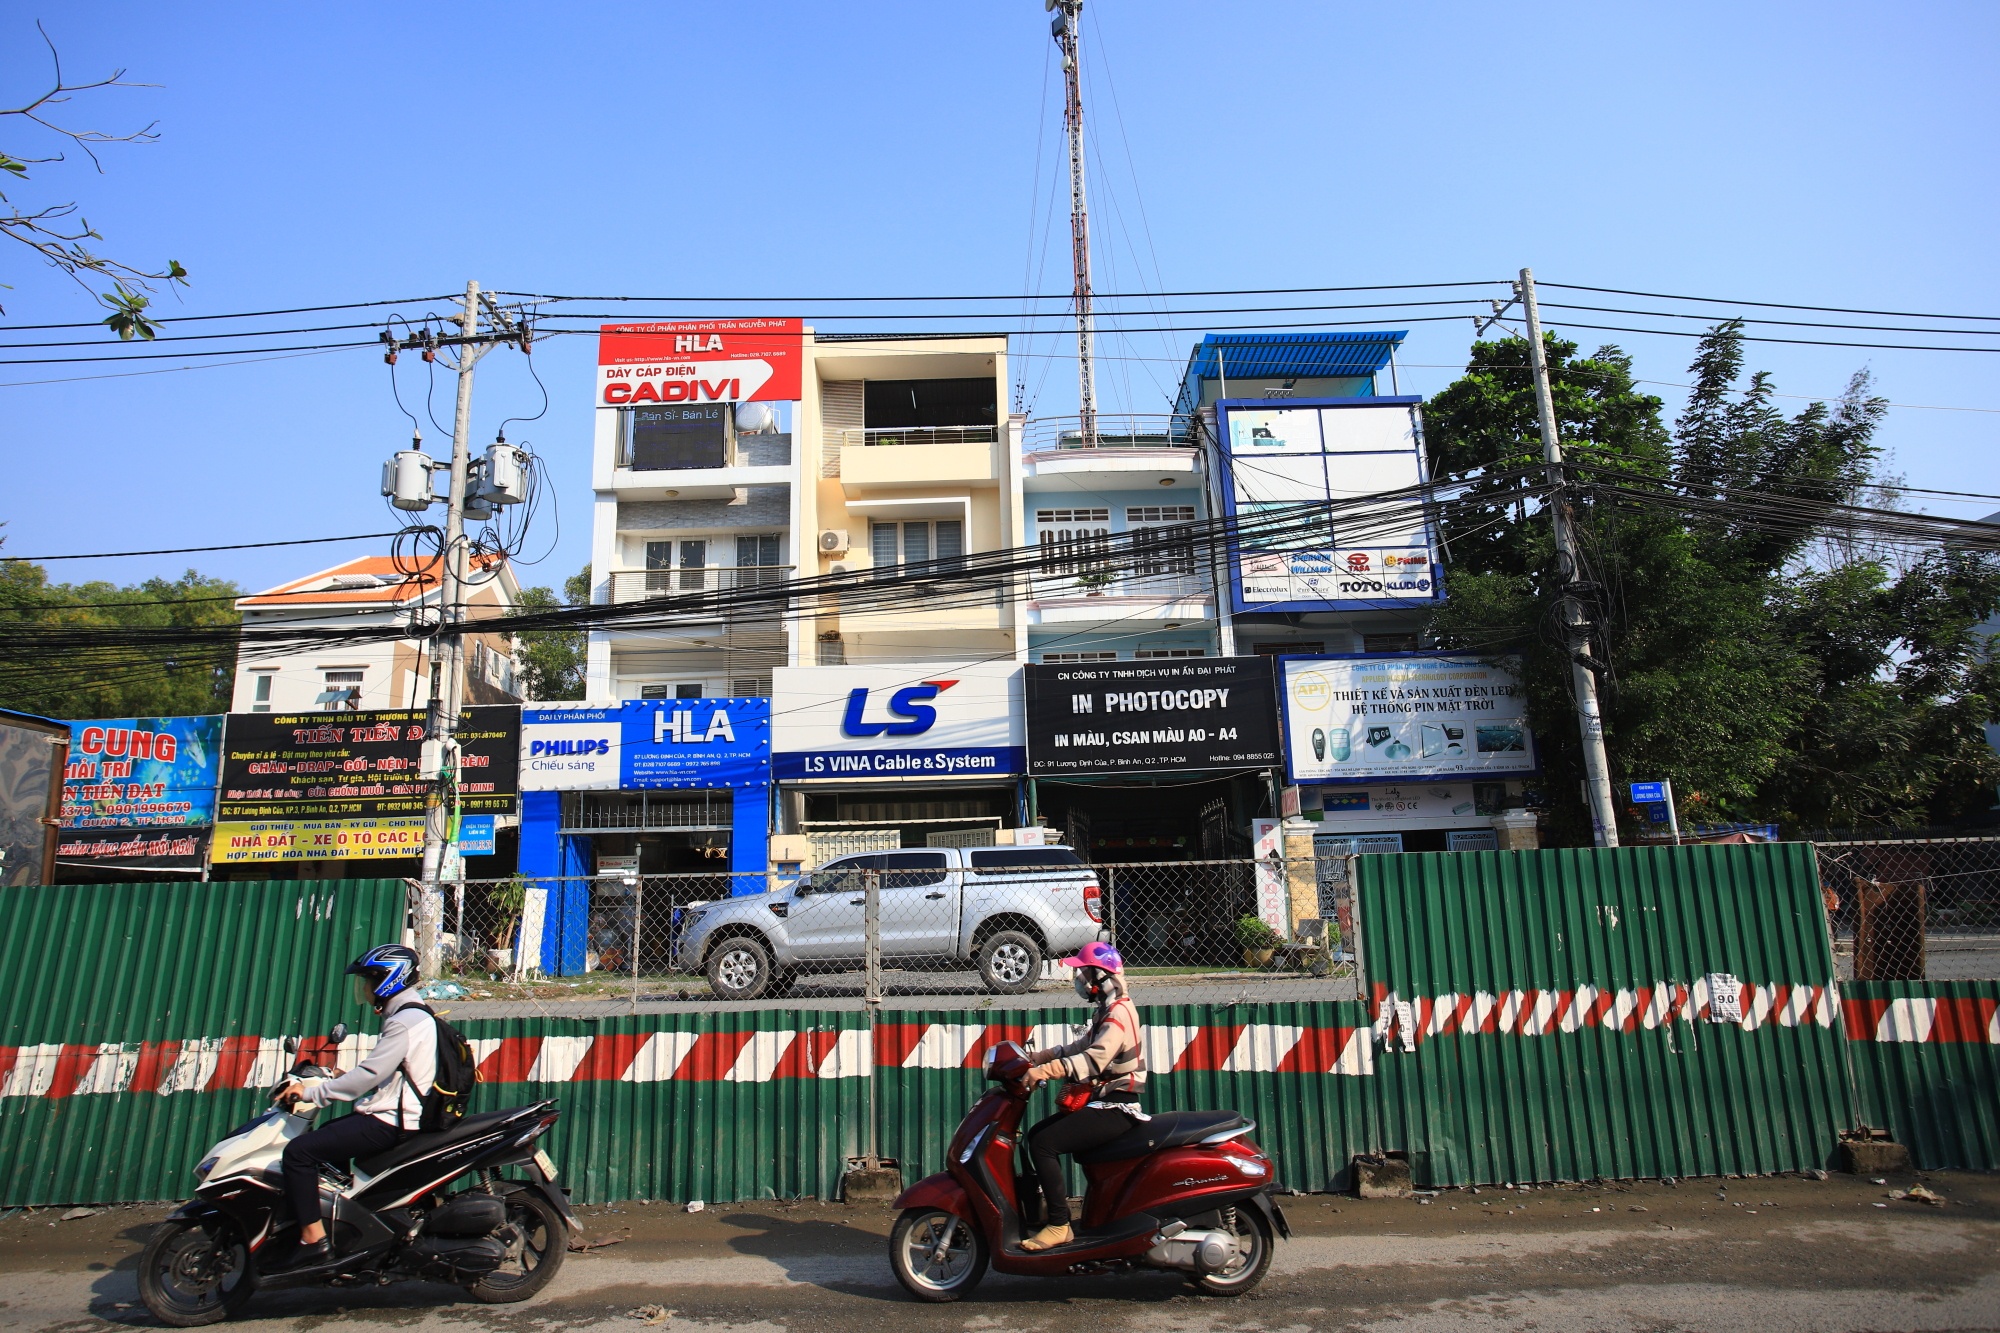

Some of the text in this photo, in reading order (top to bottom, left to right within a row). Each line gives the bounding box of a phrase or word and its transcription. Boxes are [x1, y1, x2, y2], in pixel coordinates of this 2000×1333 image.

[738, 319, 766, 328] NGUYỄN
[768, 319, 786, 327] PHÁT
[675, 334, 724, 352] HLA
[606, 364, 696, 379] DÂY CÁP ĐIỆN
[604, 378, 740, 404] CADIVI
[682, 410, 702, 420] Bán
[1398, 556, 1428, 565] PRIME
[1340, 581, 1383, 592] TOTO
[1386, 582, 1416, 590] KLUDI
[1058, 672, 1070, 680] CN
[1072, 670, 1096, 680] CÔNG
[1098, 671, 1110, 679] TY
[1112, 670, 1134, 678] TNHH
[1136, 668, 1156, 679] DỊCH
[1158, 668, 1170, 678] VỤ
[1182, 665, 1194, 676] ẤN
[1197, 666, 1212, 676] ĐẠI
[1214, 665, 1236, 674] PHÁT
[1298, 684, 1326, 695] APT
[1333, 684, 1513, 702] THIẾT KẾ VÀ SẢN XUẤT ĐÈN LED
[1072, 688, 1230, 714] IN PHOTOCOPY
[1352, 700, 1494, 716] HỆ THỐNG PIN MẶT TRỜI
[274, 716, 298, 724] CÔNG
[300, 716, 310, 724] TY
[356, 714, 367, 722] TƯ
[375, 712, 408, 721] THƯƠNG
[553, 712, 562, 721] LÝ
[563, 712, 585, 721] PHÂN
[586, 712, 606, 720] PHỐI
[843, 687, 939, 737] LS
[293, 724, 346, 744] TIẾN
[350, 722, 401, 742] TIẾN
[654, 710, 736, 744] HLA
[1054, 734, 1069, 748] IN
[1073, 730, 1110, 748] MÀU,
[1112, 730, 1150, 746] CSAN
[1152, 726, 1185, 744] MÀU
[1218, 728, 1238, 740] A4
[81, 726, 177, 764] CUNG
[530, 739, 610, 756] PHILIPS
[231, 751, 255, 762] Chuyên
[282, 750, 294, 760] Đặt
[294, 752, 308, 760] may
[309, 750, 323, 758] theo
[324, 750, 336, 760] yêu
[804, 753, 996, 772] LS VINA Cable & System
[1233, 753, 1245, 761] 094
[1246, 752, 1262, 760] 8855
[1263, 752, 1275, 760] 025
[102, 758, 134, 779] TRÍ
[248, 754, 490, 774] CHĂN DRAP GỐI NỆM RÈM
[532, 759, 596, 772] Chiếu sáng
[1056, 760, 1077, 770] Lương
[290, 775, 316, 784] Khách
[338, 774, 349, 783] Tư
[368, 773, 382, 782] Hội
[82, 778, 125, 801] TIẾN
[127, 782, 166, 802] ĐẠT
[308, 785, 326, 797] CỬA
[328, 784, 360, 796] CHỐNG
[360, 783, 384, 796] MUỖI
[470, 782, 494, 792] MINH
[106, 802, 192, 815] 0901996679
[222, 806, 233, 816] ĐC:
[234, 806, 241, 815] 87
[387, 802, 400, 811] 0932
[413, 802, 423, 810] 345
[82, 816, 186, 830] QUẬN TP.HCM
[303, 822, 322, 830] MUA
[324, 822, 342, 830] BÁN
[350, 820, 360, 829] KÝ
[362, 820, 378, 828] GỬI
[230, 832, 262, 848] NHÀ
[266, 831, 298, 848] ĐẤT
[313, 834, 333, 846] XE
[336, 830, 348, 846] Ô
[352, 830, 373, 845] TÔ
[377, 829, 408, 844] CÁC
[226, 846, 398, 860] HỢP THỨC HÓA NHÀ ĐẤT TƯ VẤN
[1718, 994, 1734, 1004] 9.0
